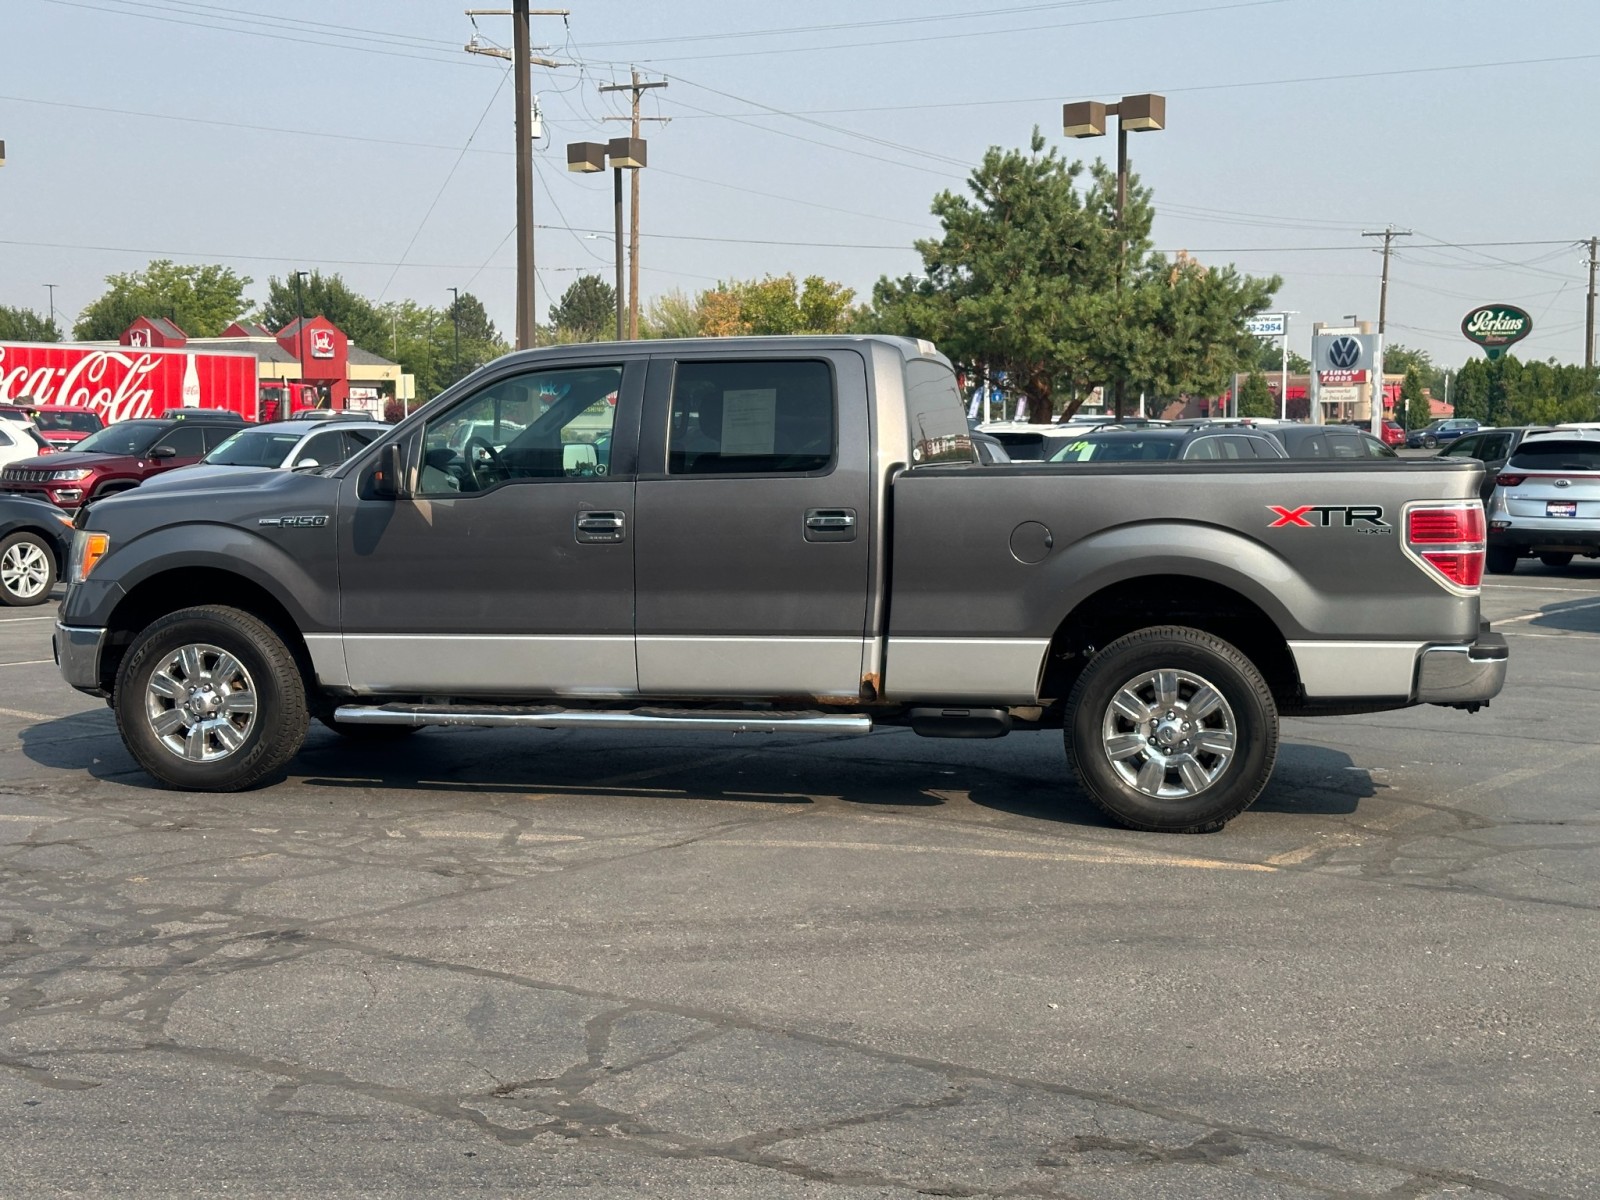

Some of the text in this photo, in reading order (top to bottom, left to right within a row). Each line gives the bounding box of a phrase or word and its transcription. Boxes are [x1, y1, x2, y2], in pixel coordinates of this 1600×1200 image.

[1467, 310, 1523, 332] Perkins
[314, 331, 335, 350] Jack
[279, 515, 329, 527] F-150
[1265, 505, 1392, 527] XTR
